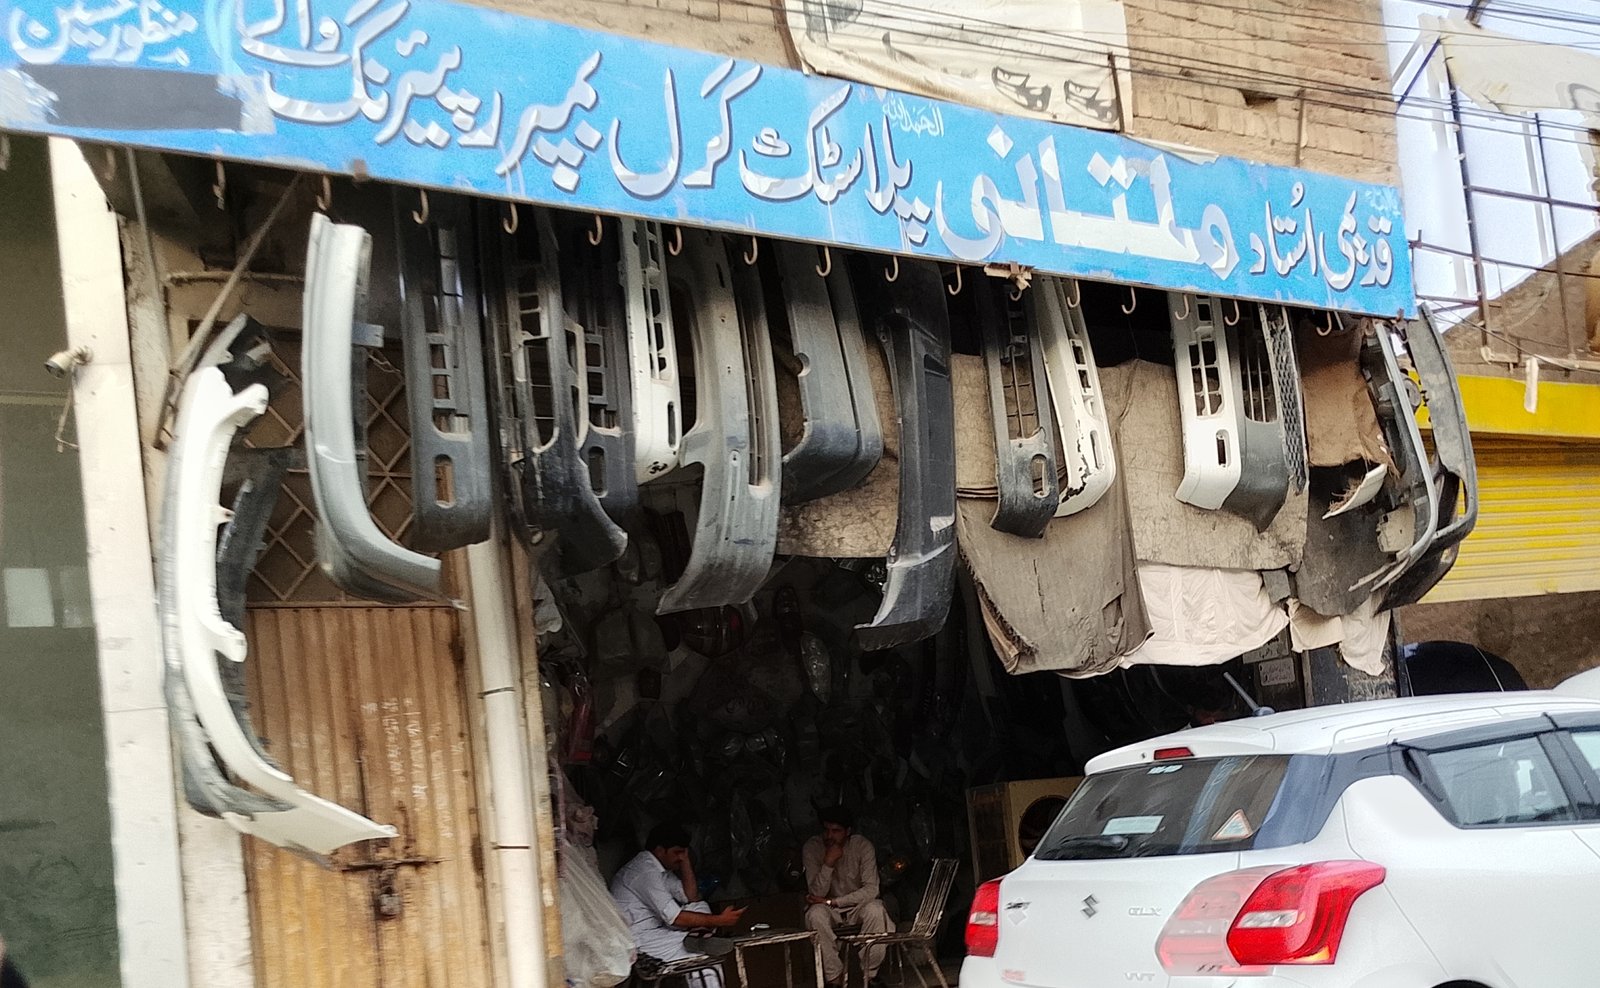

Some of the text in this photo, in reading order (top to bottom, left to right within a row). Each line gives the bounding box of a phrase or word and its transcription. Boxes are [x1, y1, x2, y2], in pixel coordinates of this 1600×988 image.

[494, 50, 604, 193] بمپر
[607, 58, 764, 200] گرل
[738, 84, 933, 244] پلاسٹک
[1128, 906, 1162, 917] GLX
